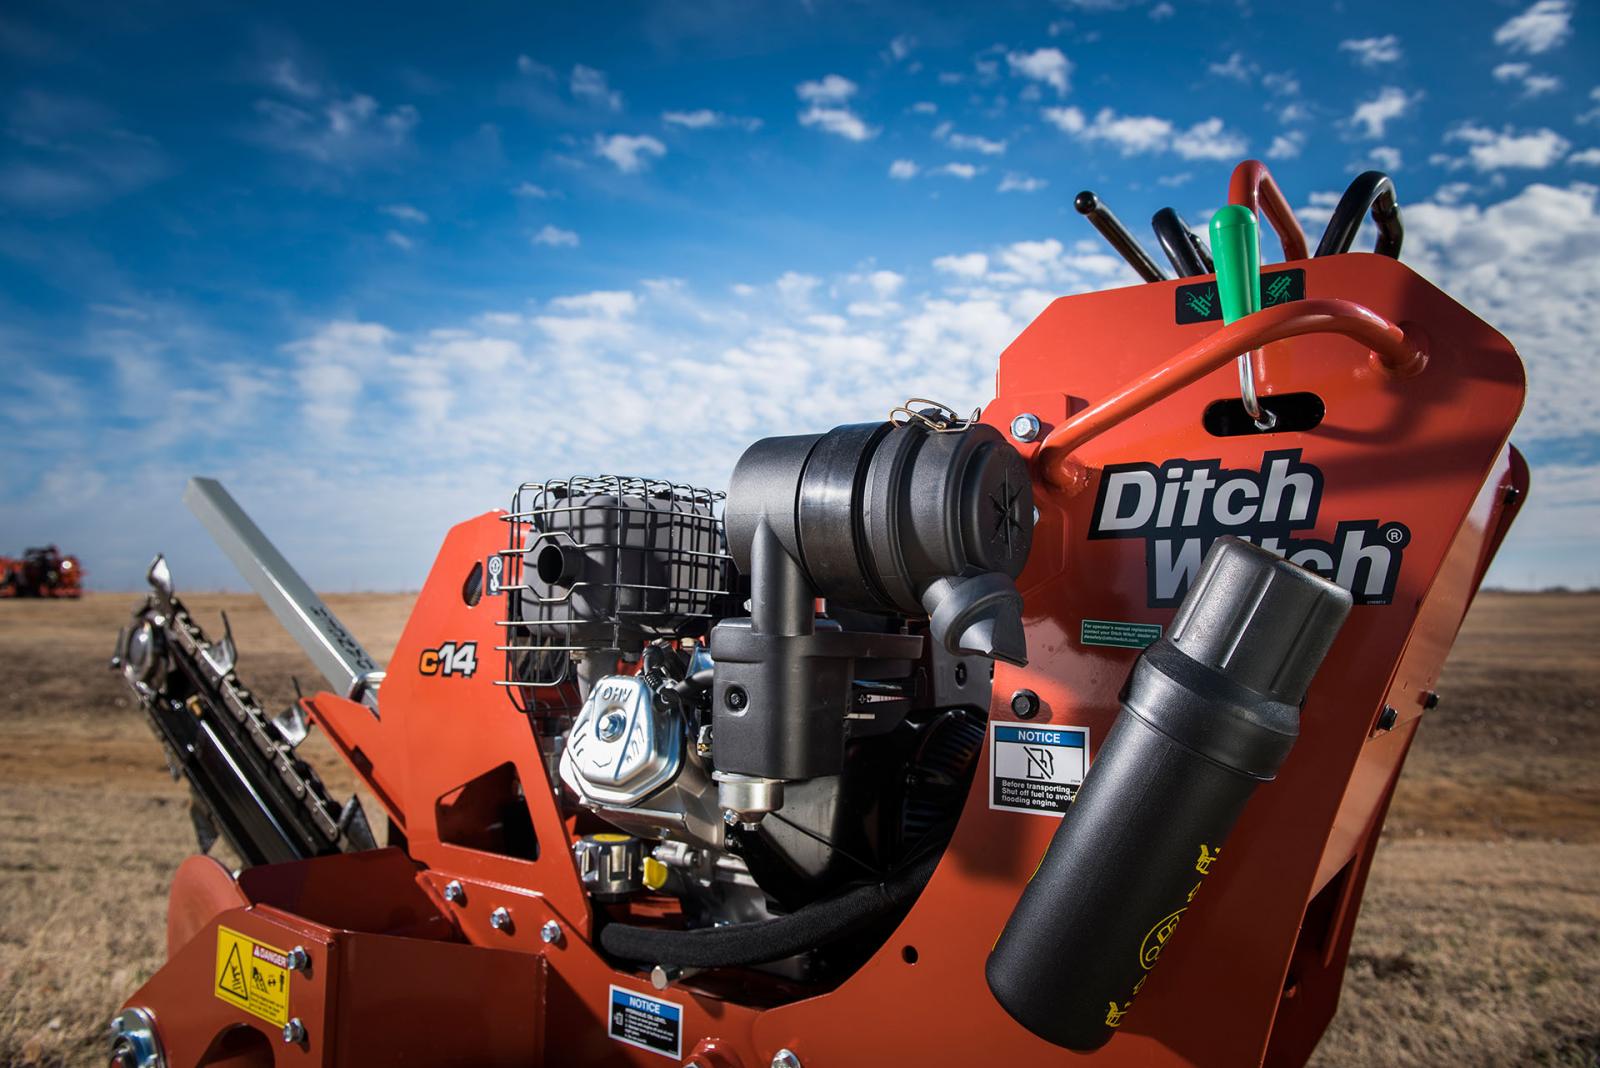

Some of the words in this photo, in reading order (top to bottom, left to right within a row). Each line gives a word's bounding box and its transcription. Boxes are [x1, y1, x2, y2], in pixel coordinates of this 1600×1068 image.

[1098, 458, 1315, 531] Ditch
[602, 686, 632, 703] OHV
[1018, 730, 1061, 743] NOTICE
[1002, 780, 1025, 789] Before
[1002, 787, 1018, 795] Shut
[1001, 795, 1031, 806] flooding
[1032, 799, 1058, 808] engine.
[259, 946, 287, 968] DANGER
[629, 996, 661, 1014] NOTICE
